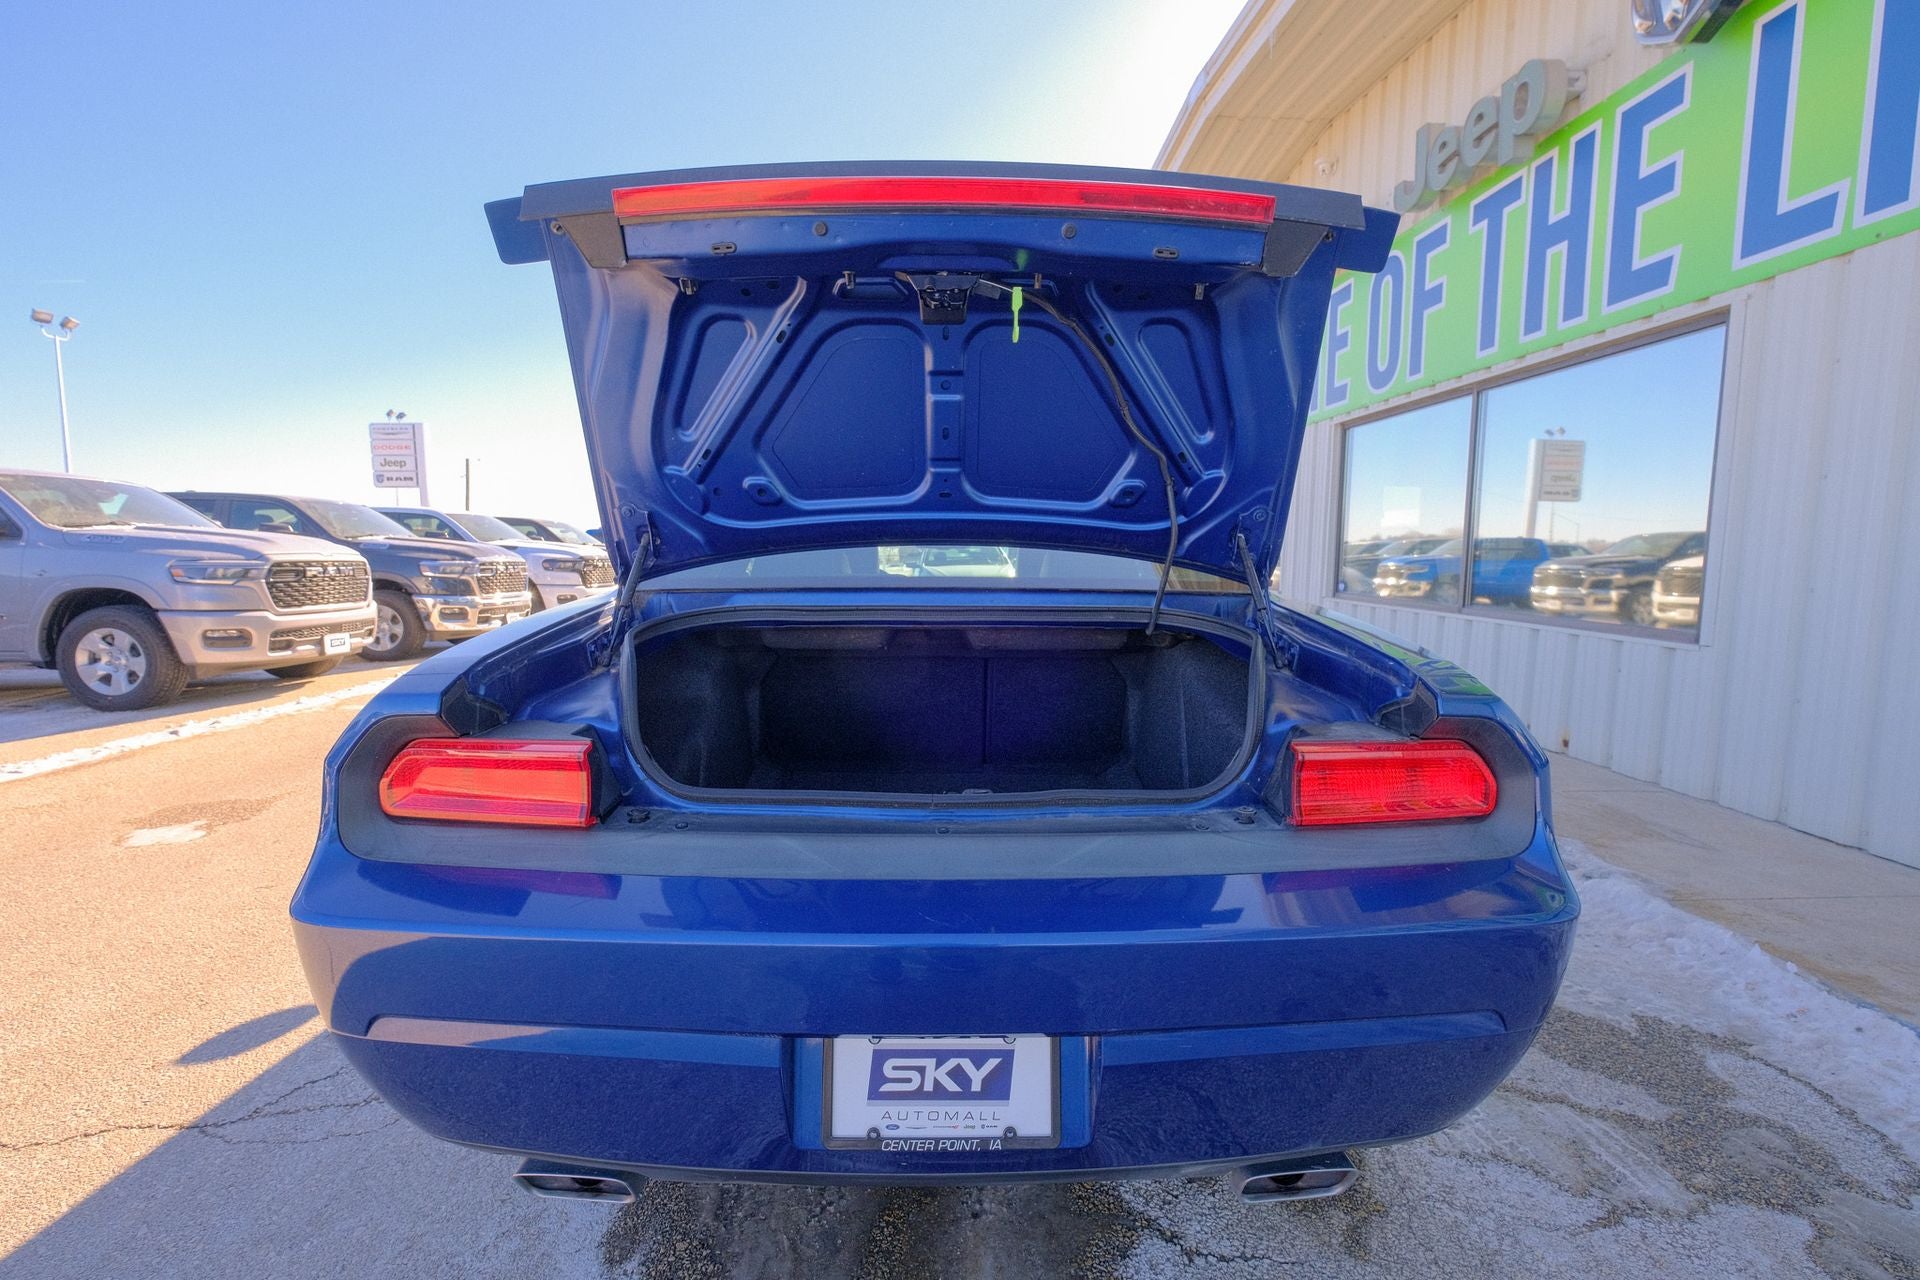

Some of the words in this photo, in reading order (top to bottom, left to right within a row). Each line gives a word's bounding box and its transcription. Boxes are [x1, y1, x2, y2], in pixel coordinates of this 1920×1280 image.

[1393, 59, 1567, 214] Jeep
[1308, 277, 1354, 416] E
[1365, 214, 1451, 394] OF
[1469, 61, 1694, 359] THE
[380, 457, 407, 469] Jeep
[878, 1057, 1003, 1092] SKY
[881, 1110, 1001, 1121] AUTOMALL
[881, 1139, 935, 1151] CENTER
[938, 1139, 980, 1152] POINT,
[989, 1139, 1002, 1151] IA
